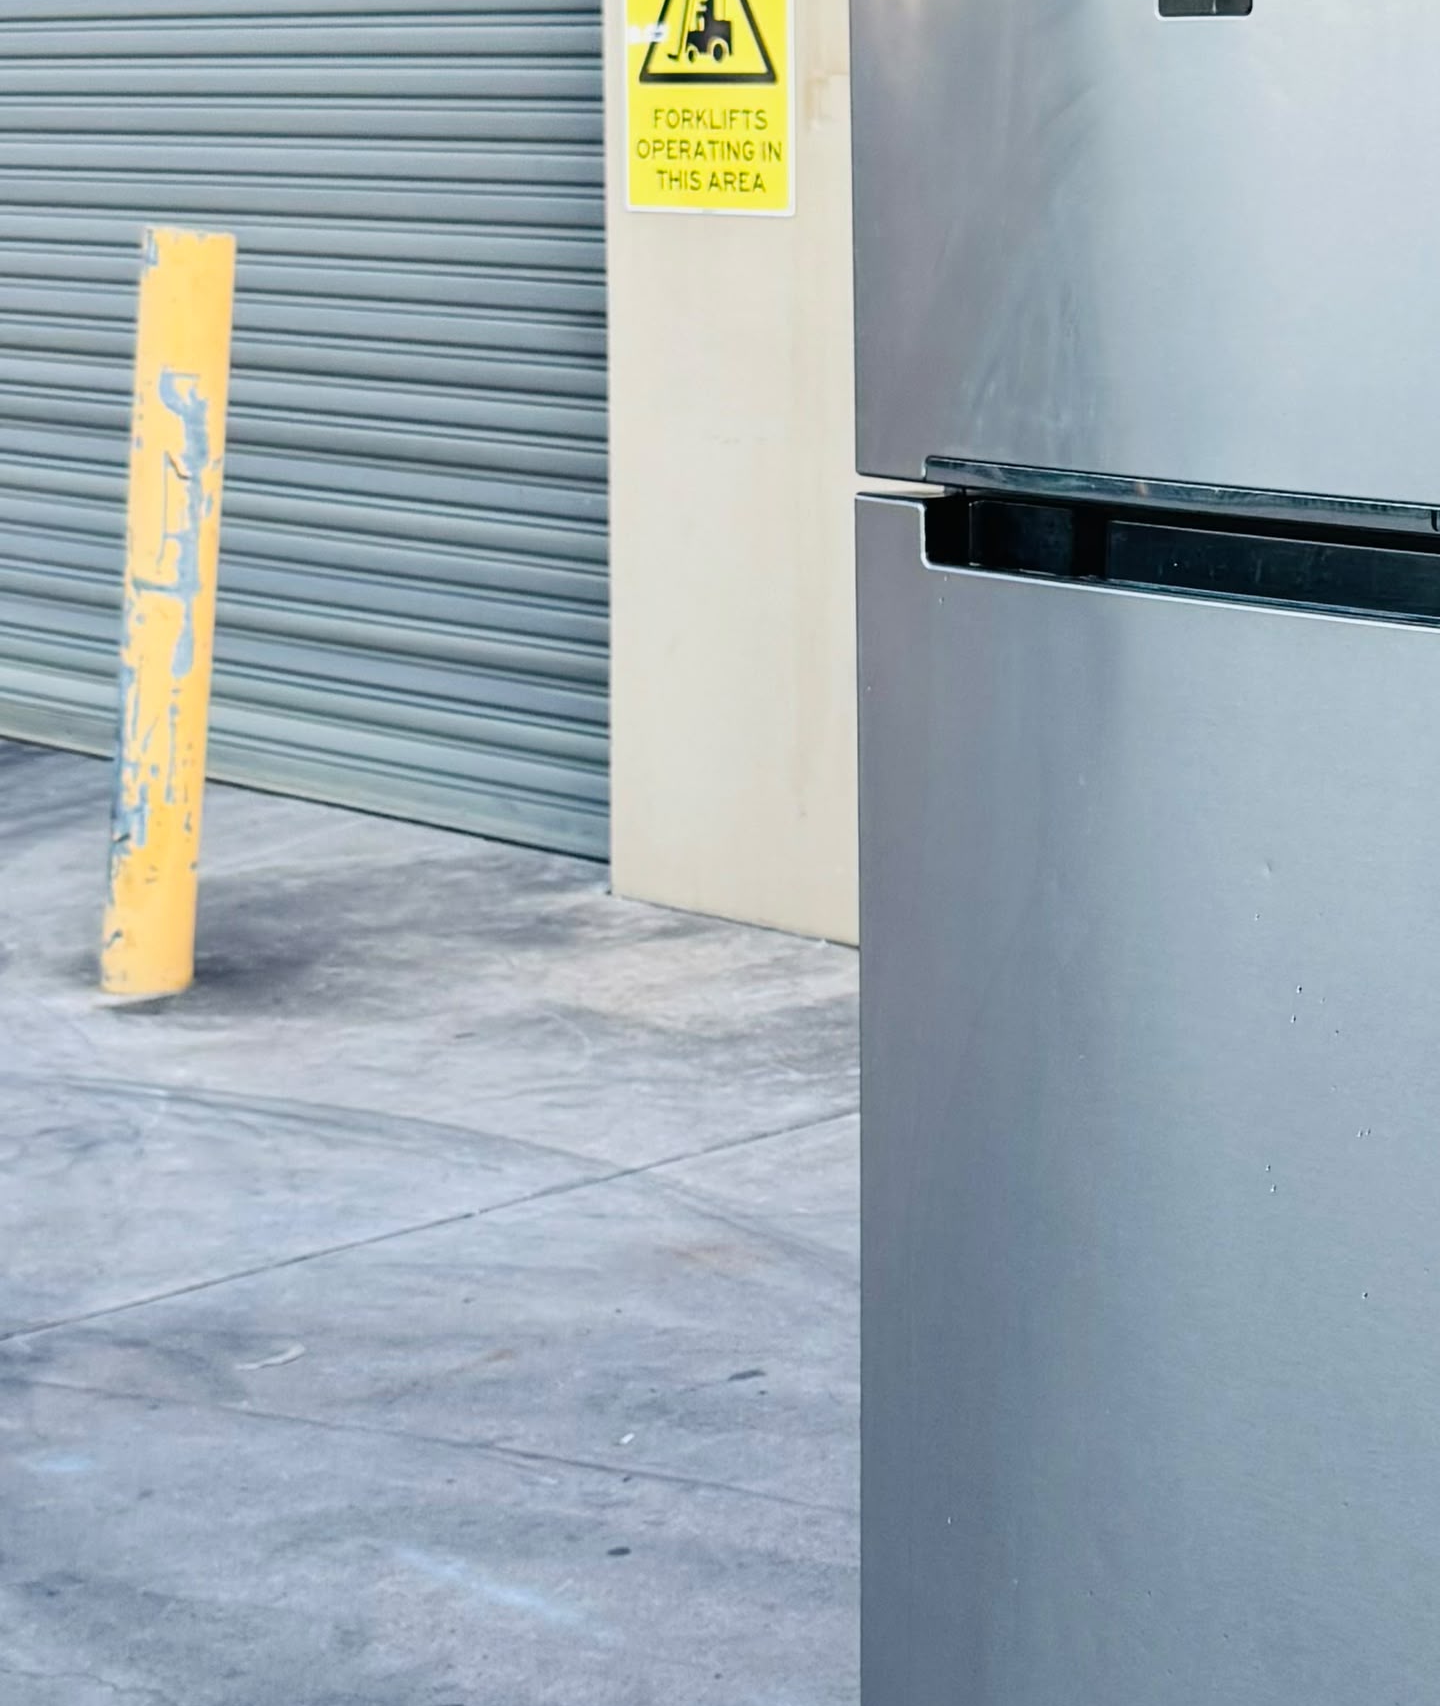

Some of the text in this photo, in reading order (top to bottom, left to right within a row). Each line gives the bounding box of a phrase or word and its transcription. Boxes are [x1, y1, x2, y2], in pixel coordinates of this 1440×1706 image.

[653, 108, 768, 131] FORKLIFTS
[636, 139, 782, 162] OPERATING IN
[657, 169, 767, 193] THIS AREA
